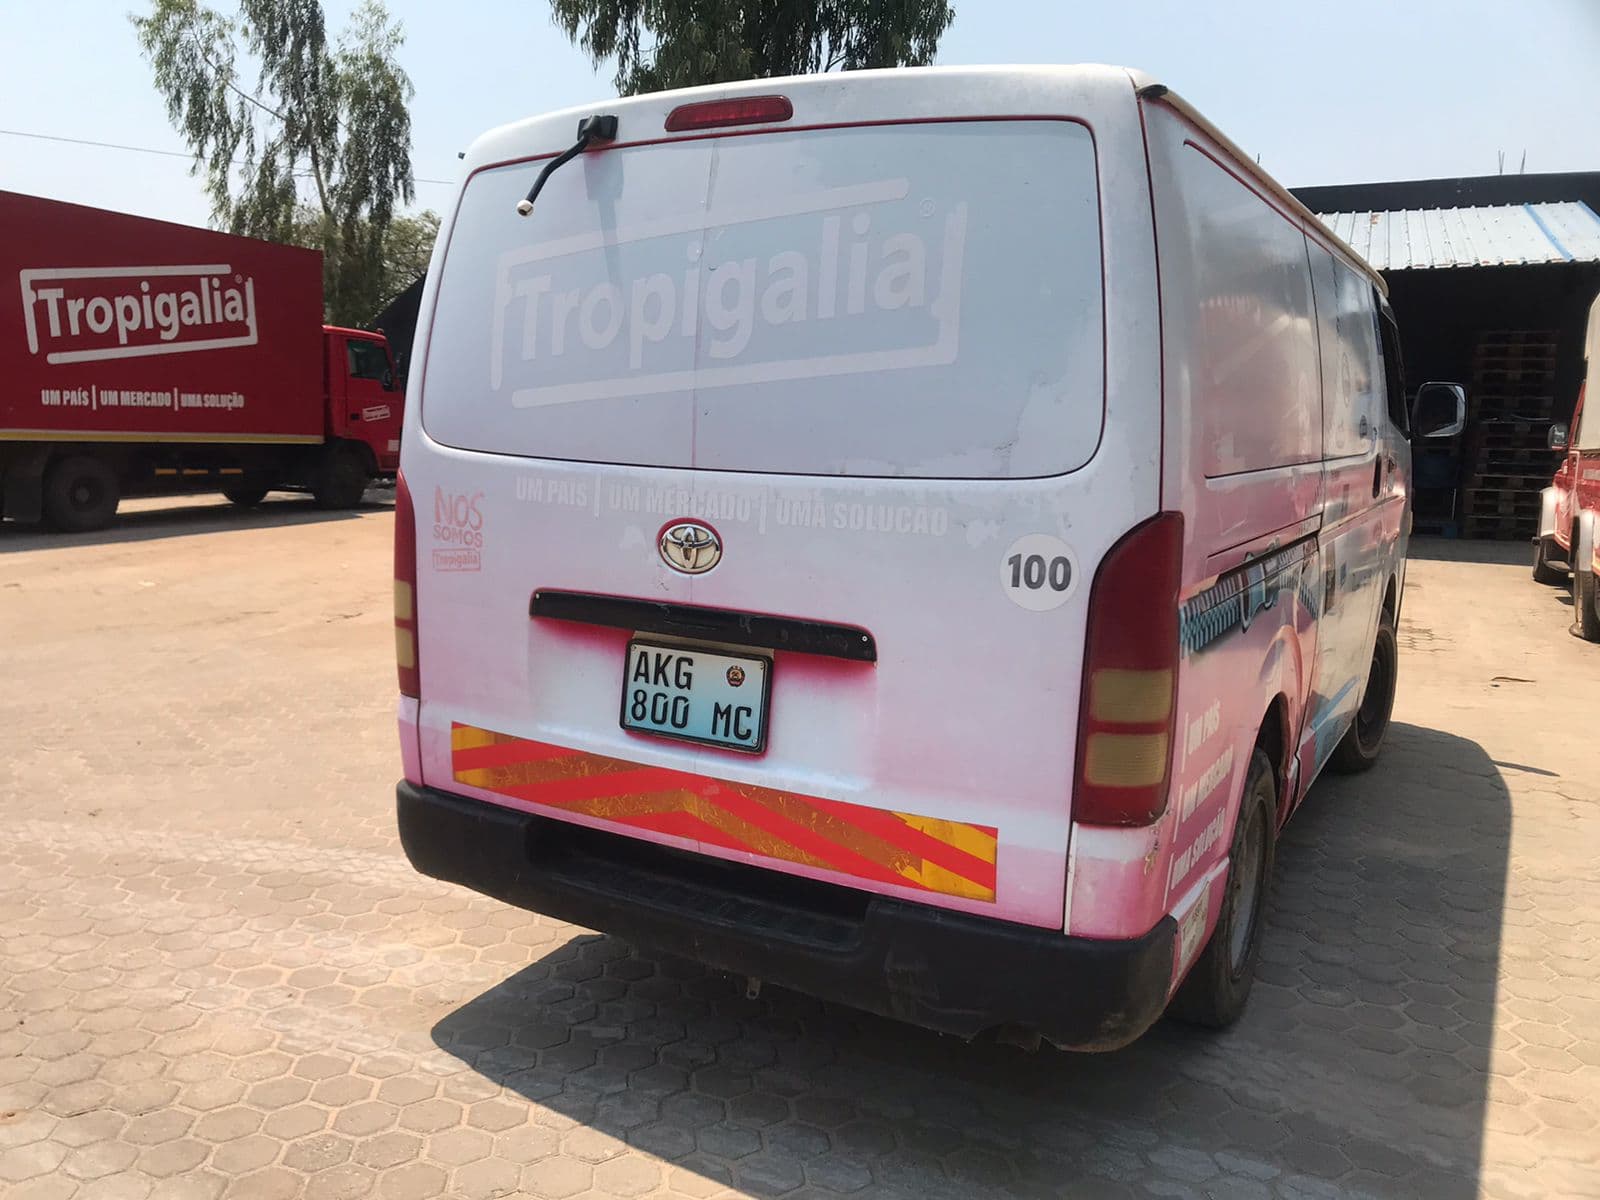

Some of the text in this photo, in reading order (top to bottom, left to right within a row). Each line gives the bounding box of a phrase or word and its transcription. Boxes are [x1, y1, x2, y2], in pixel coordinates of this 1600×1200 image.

[511, 213, 928, 368] Tropigalia
[37, 278, 245, 344] Tropigalia
[41, 386, 245, 411] UM PAÍS UM MERCADO UMA SOLUÇÃO
[775, 495, 826, 529] UMA
[432, 524, 483, 549] SOMOS
[1007, 553, 1072, 592] 100
[633, 651, 694, 691] AKG
[630, 689, 752, 741] 800 MC
